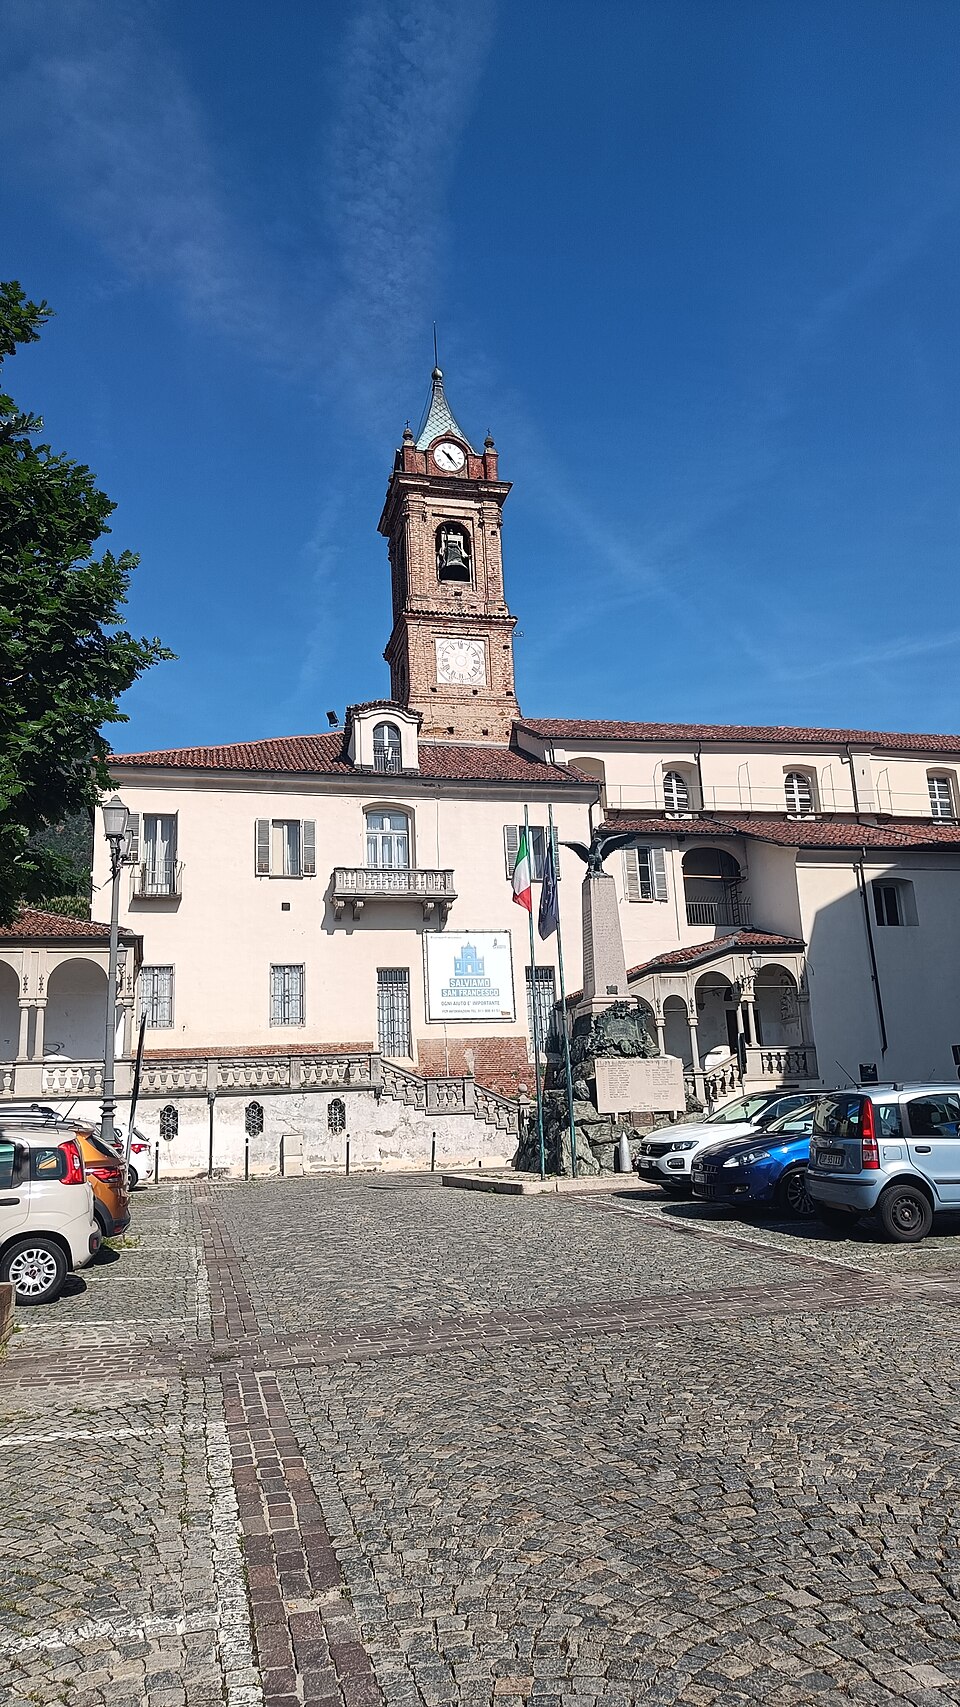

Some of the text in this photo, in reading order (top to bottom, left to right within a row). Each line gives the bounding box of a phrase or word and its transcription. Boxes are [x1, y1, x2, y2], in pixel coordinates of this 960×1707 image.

[450, 979, 490, 987] SALVIAMO
[442, 989, 499, 997] SAN FRANCESCO
